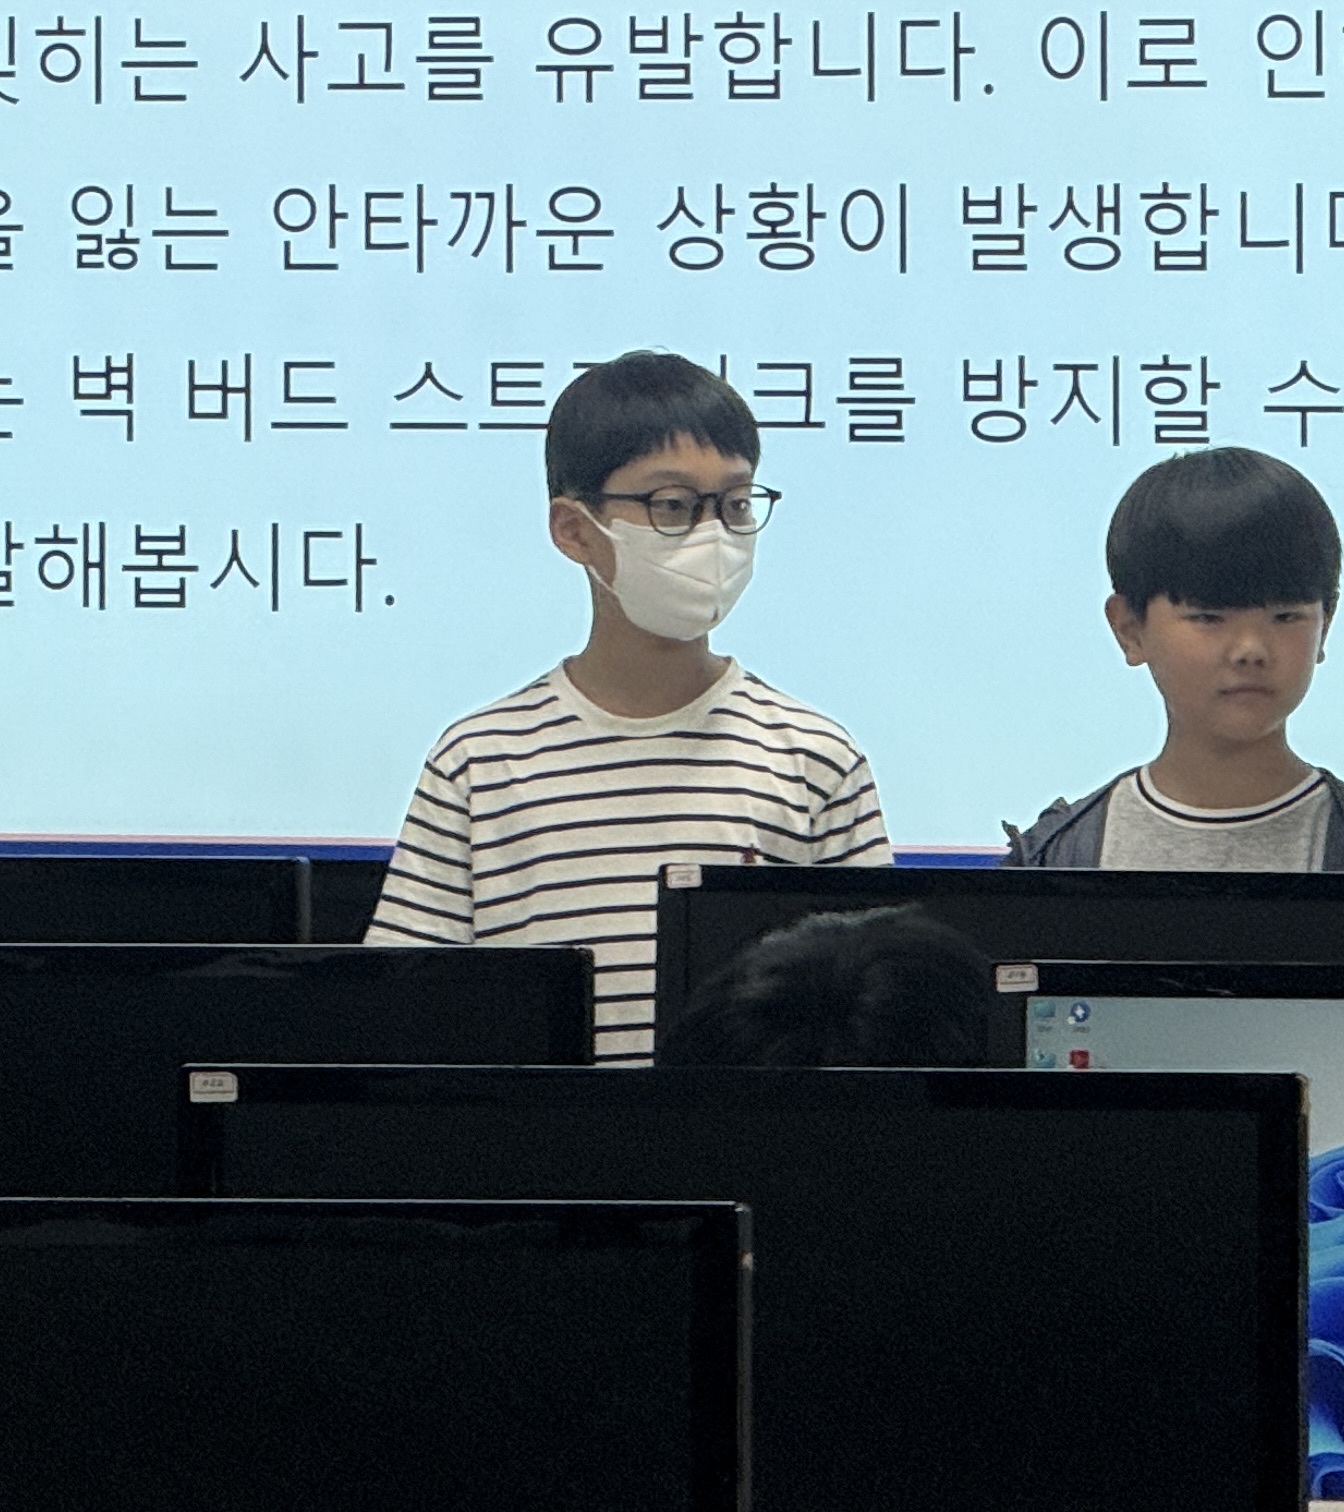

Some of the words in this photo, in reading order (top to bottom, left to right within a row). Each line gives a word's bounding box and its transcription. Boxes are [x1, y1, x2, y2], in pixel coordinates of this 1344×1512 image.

[240, 14, 494, 104] 사고를
[535, 11, 996, 103] 유발합니다.
[1041, 10, 1209, 102] 이로
[70, 184, 230, 271] 잃는
[272, 183, 615, 273] 안타까운
[657, 182, 910, 274] 상황이
[71, 353, 135, 442] 벽
[188, 353, 349, 442] 버드
[389, 356, 916, 443] 스트크를
[963, 355, 1221, 450] 방지할
